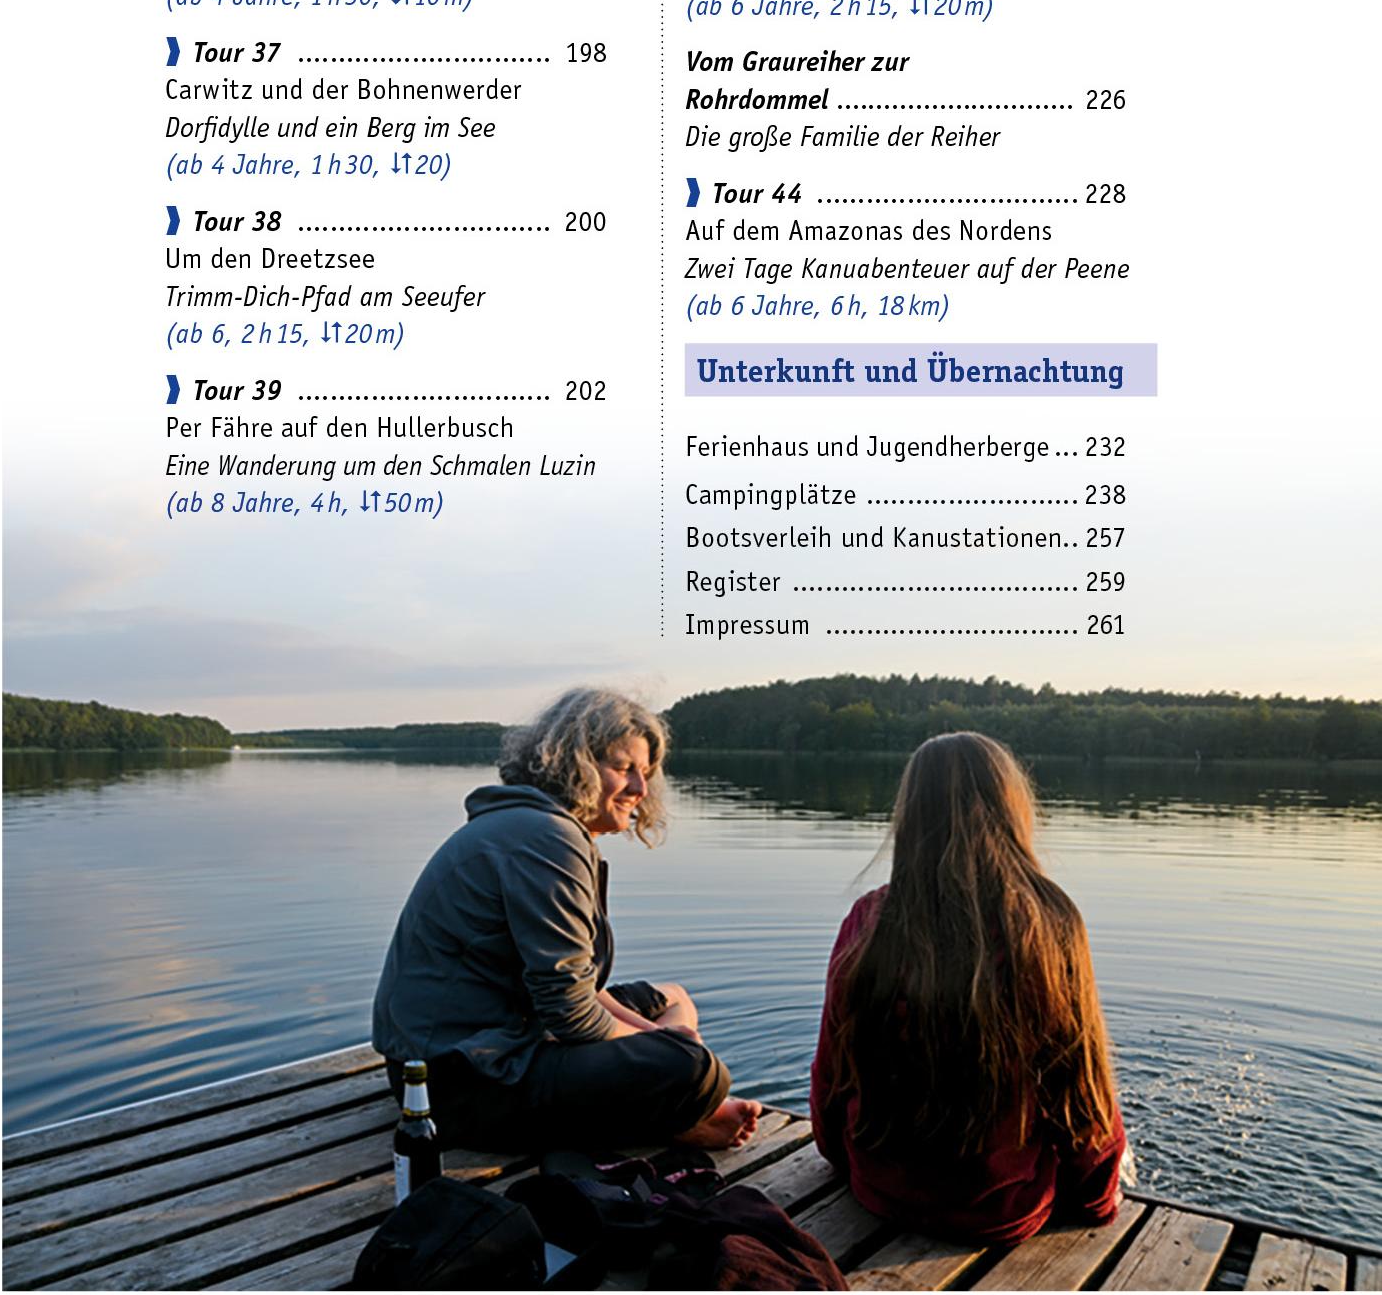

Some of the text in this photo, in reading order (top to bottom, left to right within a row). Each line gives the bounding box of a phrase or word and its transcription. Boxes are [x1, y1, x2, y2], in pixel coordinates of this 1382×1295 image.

[165, 77, 522, 100] Carwitz und der Bohnenwerder
[685, 124, 1002, 153] Die große Familie der Reiher
[713, 182, 1126, 204] Tour 44 228
[696, 351, 1124, 390] Unterkunft und Übernachtung
[167, 415, 513, 438] Per Fähre auf den Hullerbusch
[687, 434, 1125, 463] Ferienhaus und Jugendherberge 232
[686, 482, 1126, 511] Campingplätze 238
[687, 569, 1125, 598] Register 259
[685, 613, 1125, 641] Impressum 261
